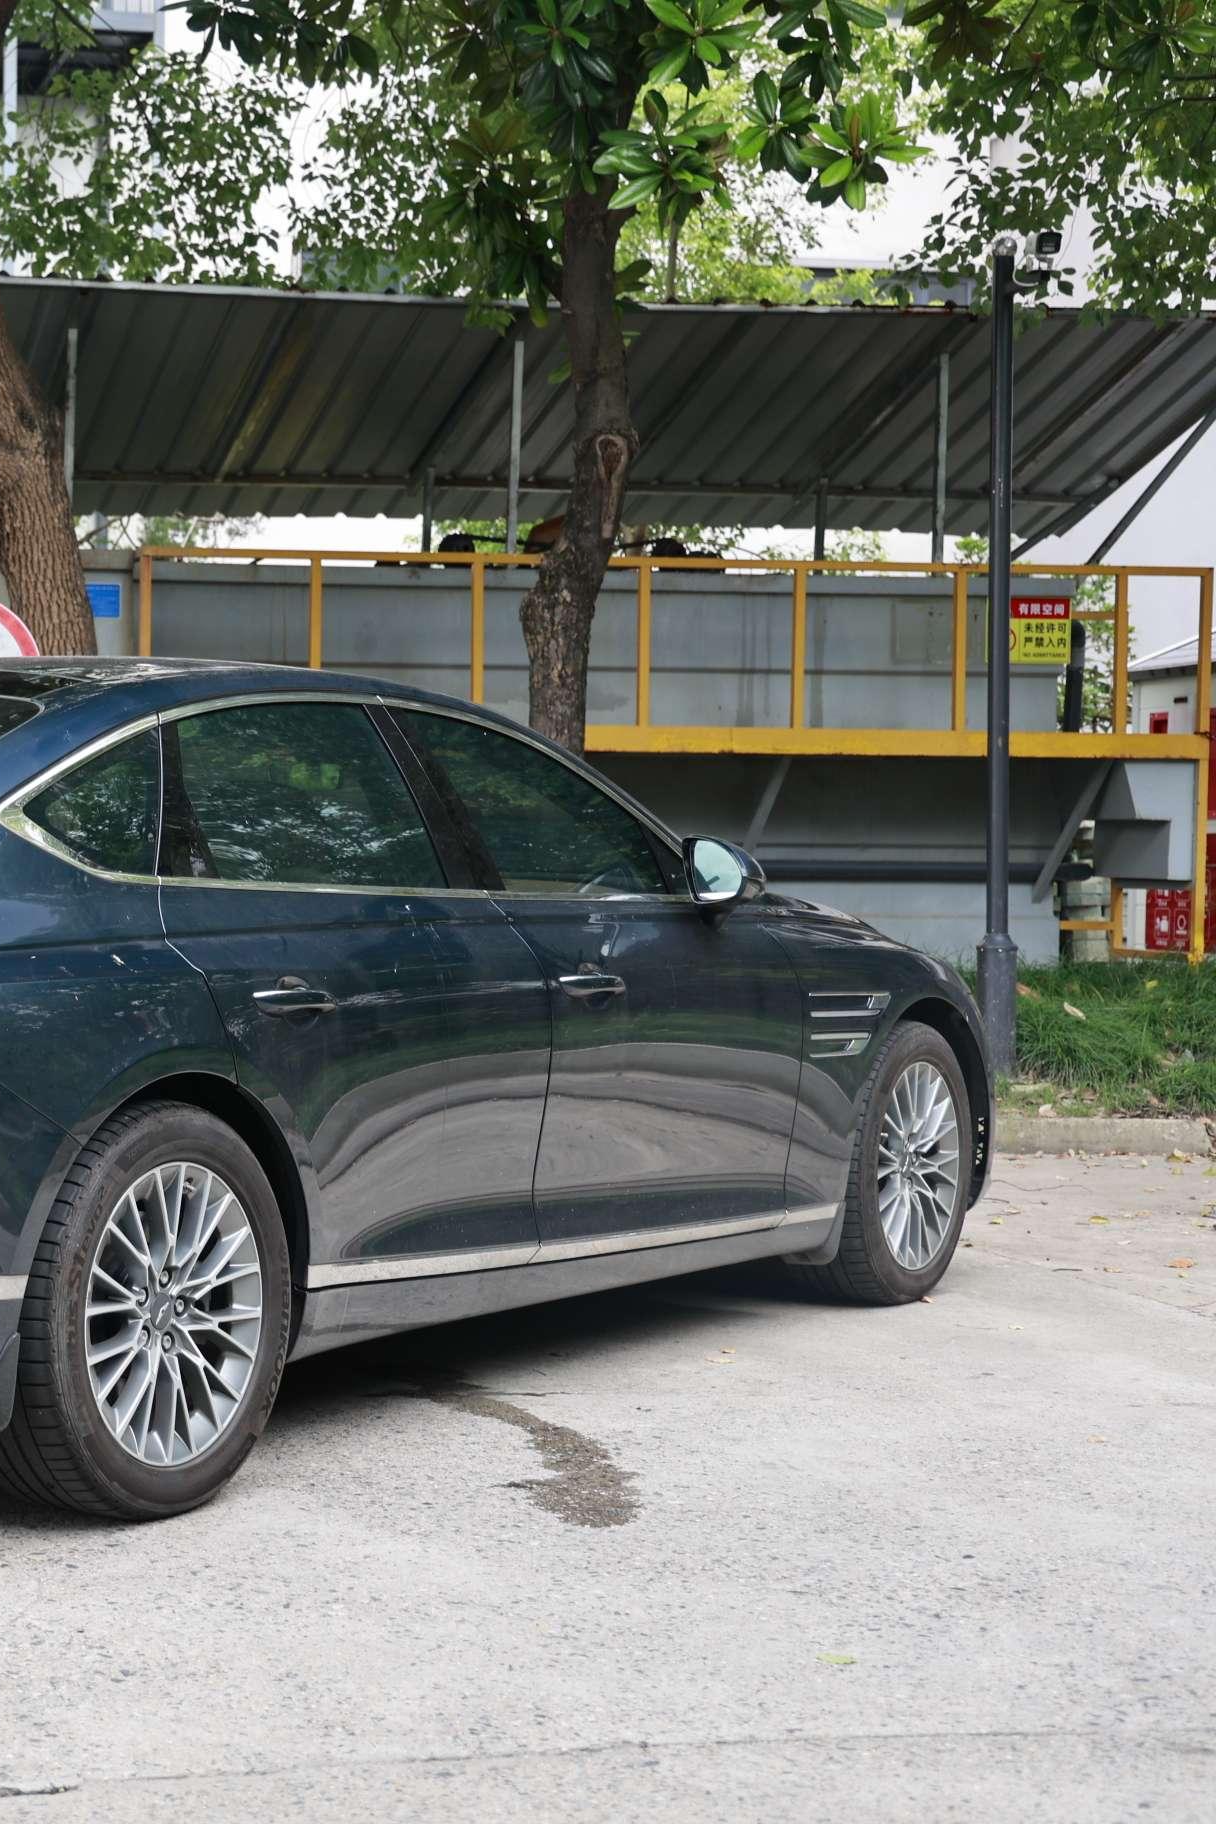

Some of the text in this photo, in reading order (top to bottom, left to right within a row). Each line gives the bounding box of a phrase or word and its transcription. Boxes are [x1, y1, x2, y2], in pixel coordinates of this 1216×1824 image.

[1019, 603, 1064, 616] 有限空间
[1024, 622, 1066, 634] 未经许可
[1024, 637, 1066, 648] 严禁入内
